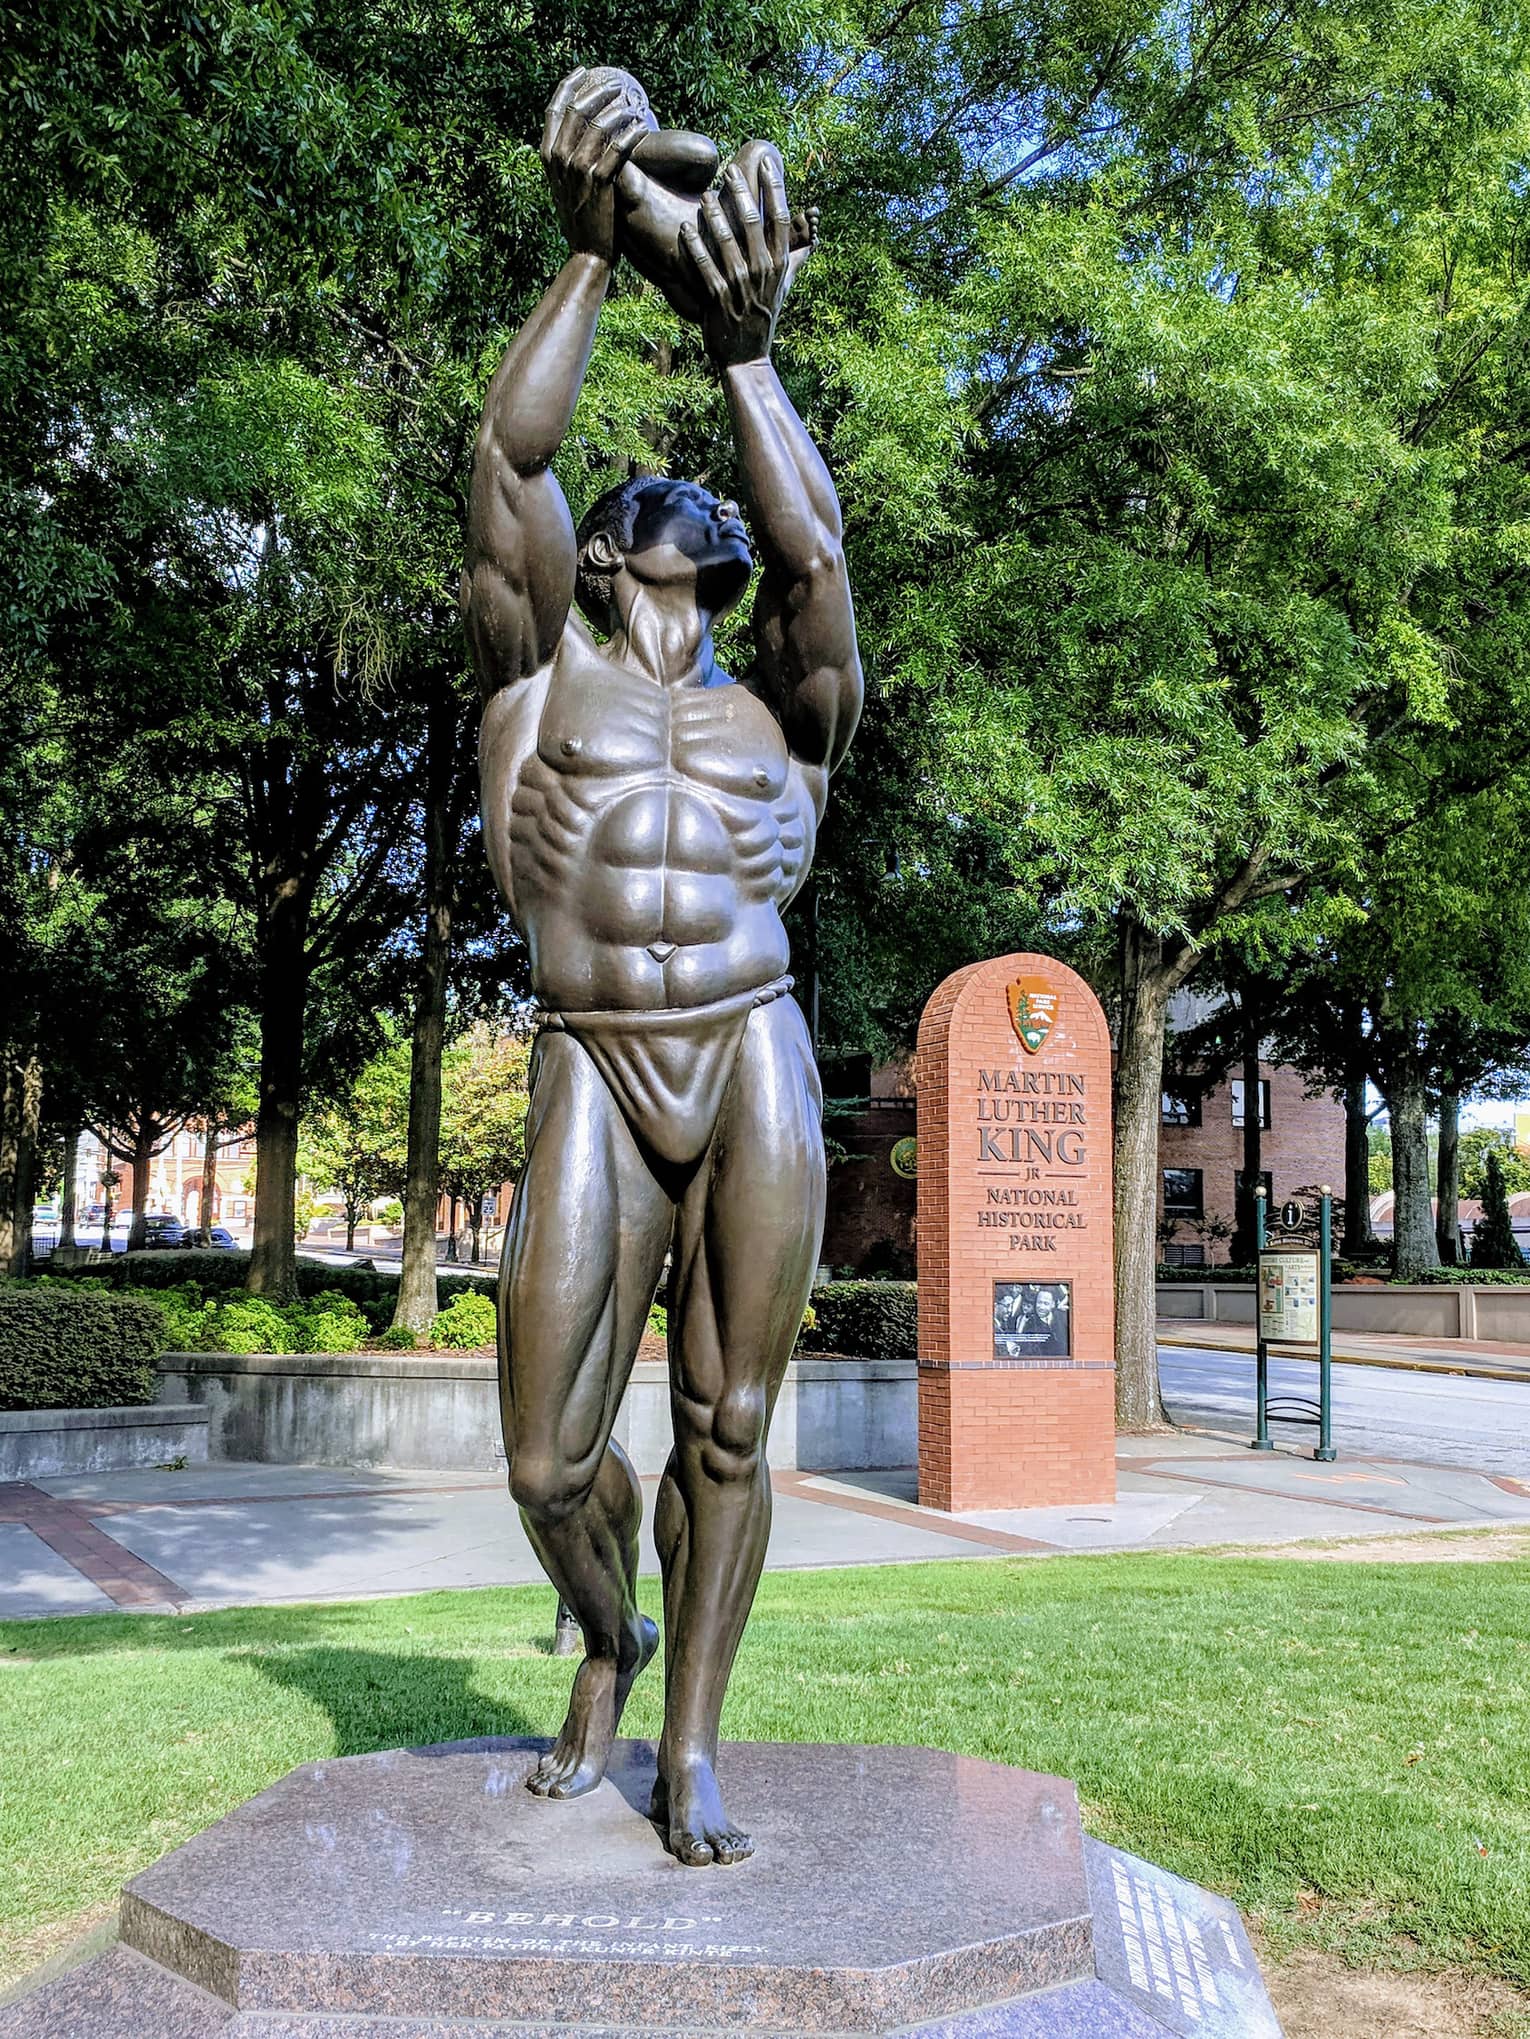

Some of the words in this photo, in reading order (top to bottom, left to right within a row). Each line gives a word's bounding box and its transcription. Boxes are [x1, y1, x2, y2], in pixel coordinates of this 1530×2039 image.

[977, 1069, 1086, 1095] MARTIN
[977, 1098, 1087, 1124] LUTHER
[977, 1126, 1087, 1165] KING
[1024, 1167, 1040, 1181] JR
[987, 1188, 1079, 1207] NATIONAL
[483, 1206, 495, 1214] 25
[977, 1211, 1087, 1229] HISTORICAL
[1009, 1234, 1057, 1251] PARK
